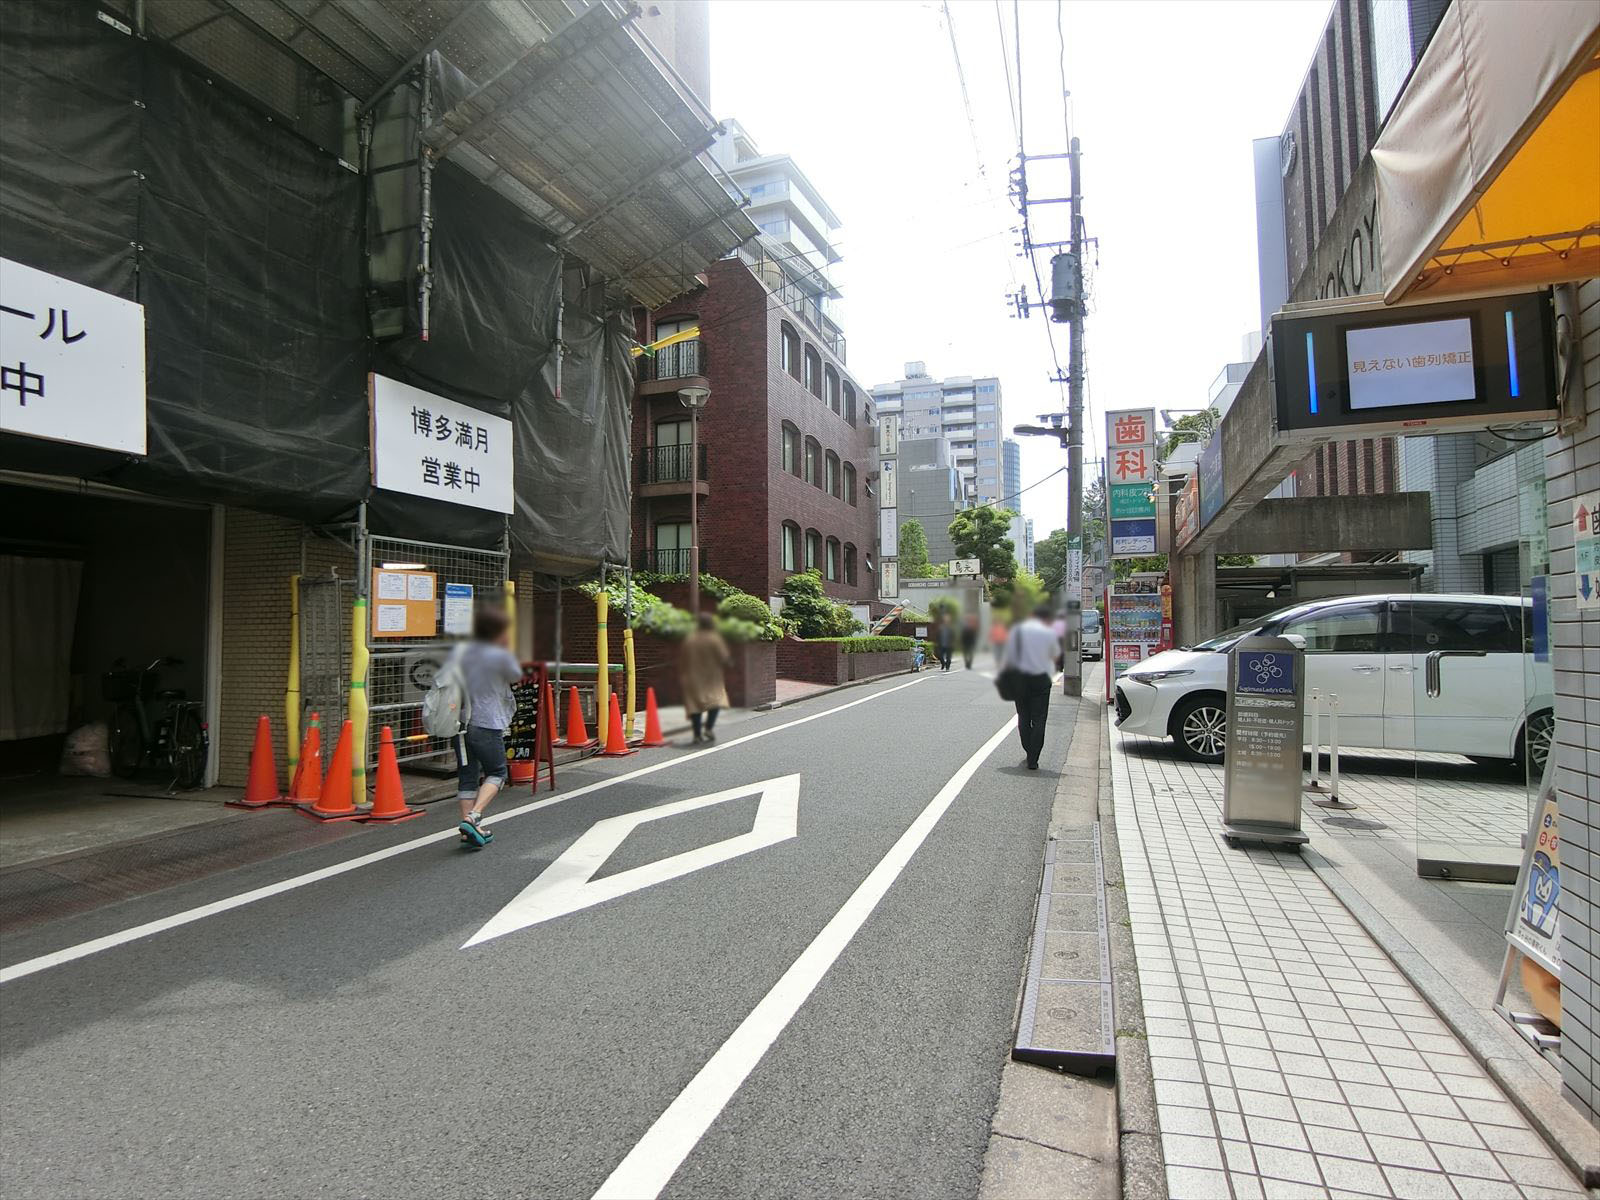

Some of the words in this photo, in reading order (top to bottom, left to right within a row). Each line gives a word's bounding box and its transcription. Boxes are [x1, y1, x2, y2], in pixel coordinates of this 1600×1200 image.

[0, 304, 87, 345] ール
[1353, 351, 1471, 374] 見えない歯列矯正
[0, 361, 45, 407] 中
[411, 405, 489, 454] 博多満月
[1115, 414, 1148, 481] 歯科
[421, 456, 481, 494] 営業中
[1262, 686, 1279, 694] Lady's
